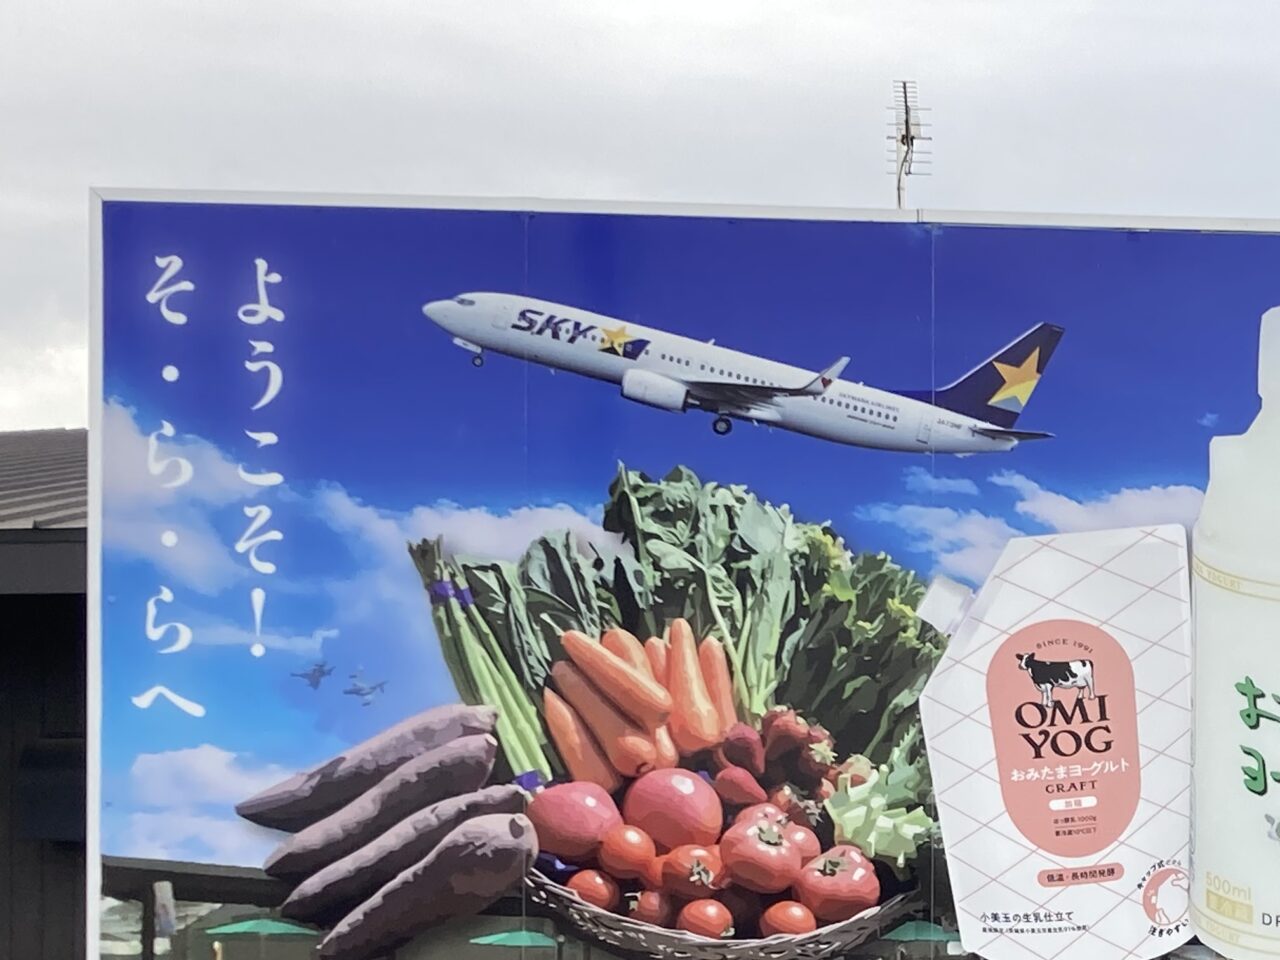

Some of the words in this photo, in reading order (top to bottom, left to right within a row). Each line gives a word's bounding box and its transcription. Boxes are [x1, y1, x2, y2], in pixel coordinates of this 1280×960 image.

[511, 308, 599, 346] SKY
[131, 254, 206, 719] そ・ら・らへ
[1035, 638, 1069, 650] SINCE
[1072, 640, 1094, 655] 1991
[1014, 694, 1111, 729] OMI
[1018, 725, 1114, 759] YOG
[1010, 758, 1131, 782] おみたまヨーグルト
[1045, 780, 1099, 795] CRAFT
[980, 911, 1075, 924] 小美玉の生乳仕立て
